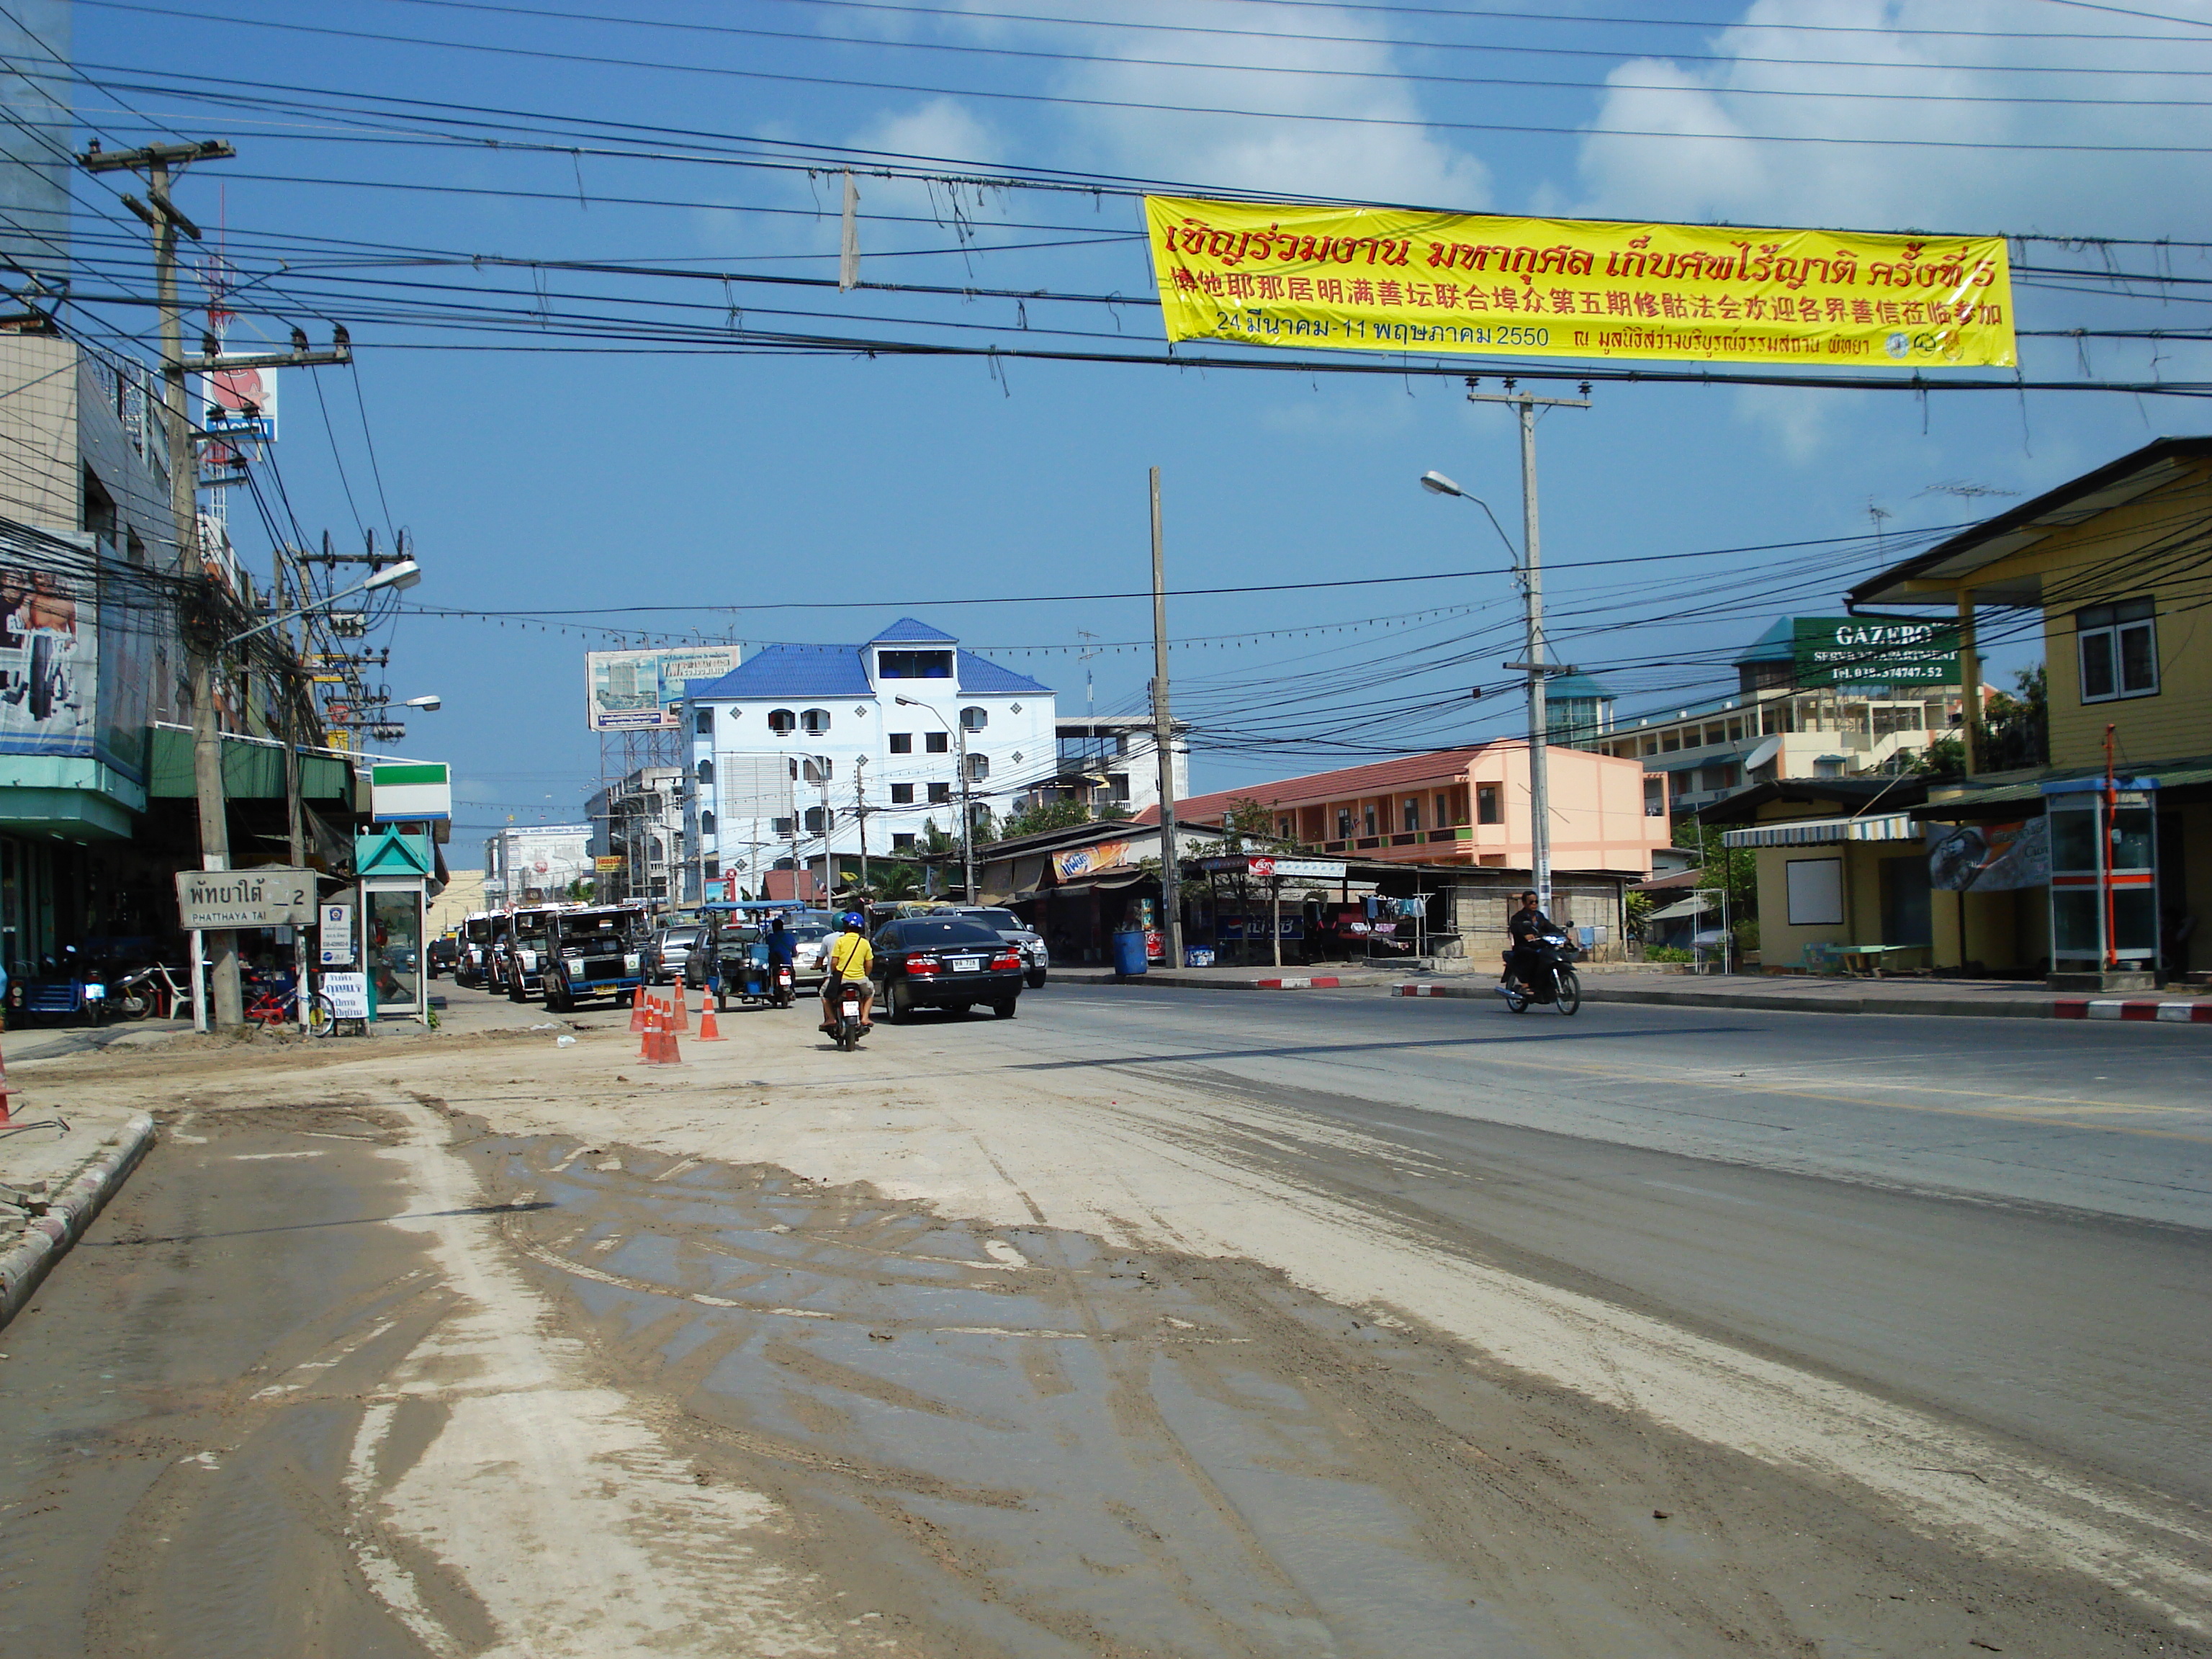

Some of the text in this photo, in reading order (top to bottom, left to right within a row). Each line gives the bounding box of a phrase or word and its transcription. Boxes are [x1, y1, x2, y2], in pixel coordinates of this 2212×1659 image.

[1164, 217, 1411, 267] เชิญร่วมงาน
[1426, 241, 1594, 286] มหากุศล
[1604, 235, 1857, 290] เก็บศพไร้ญาติ
[1216, 311, 1241, 331] 24
[1373, 323, 1491, 345] พฤษภาคม
[1497, 326, 1550, 346] 2550
[1828, 336, 1869, 355] พัทยา
[1836, 625, 1932, 645] GAZEBO
[189, 877, 266, 904] พัทยาใต้
[292, 889, 305, 906] 2
[192, 911, 266, 922] PHATTHAYA TAI
